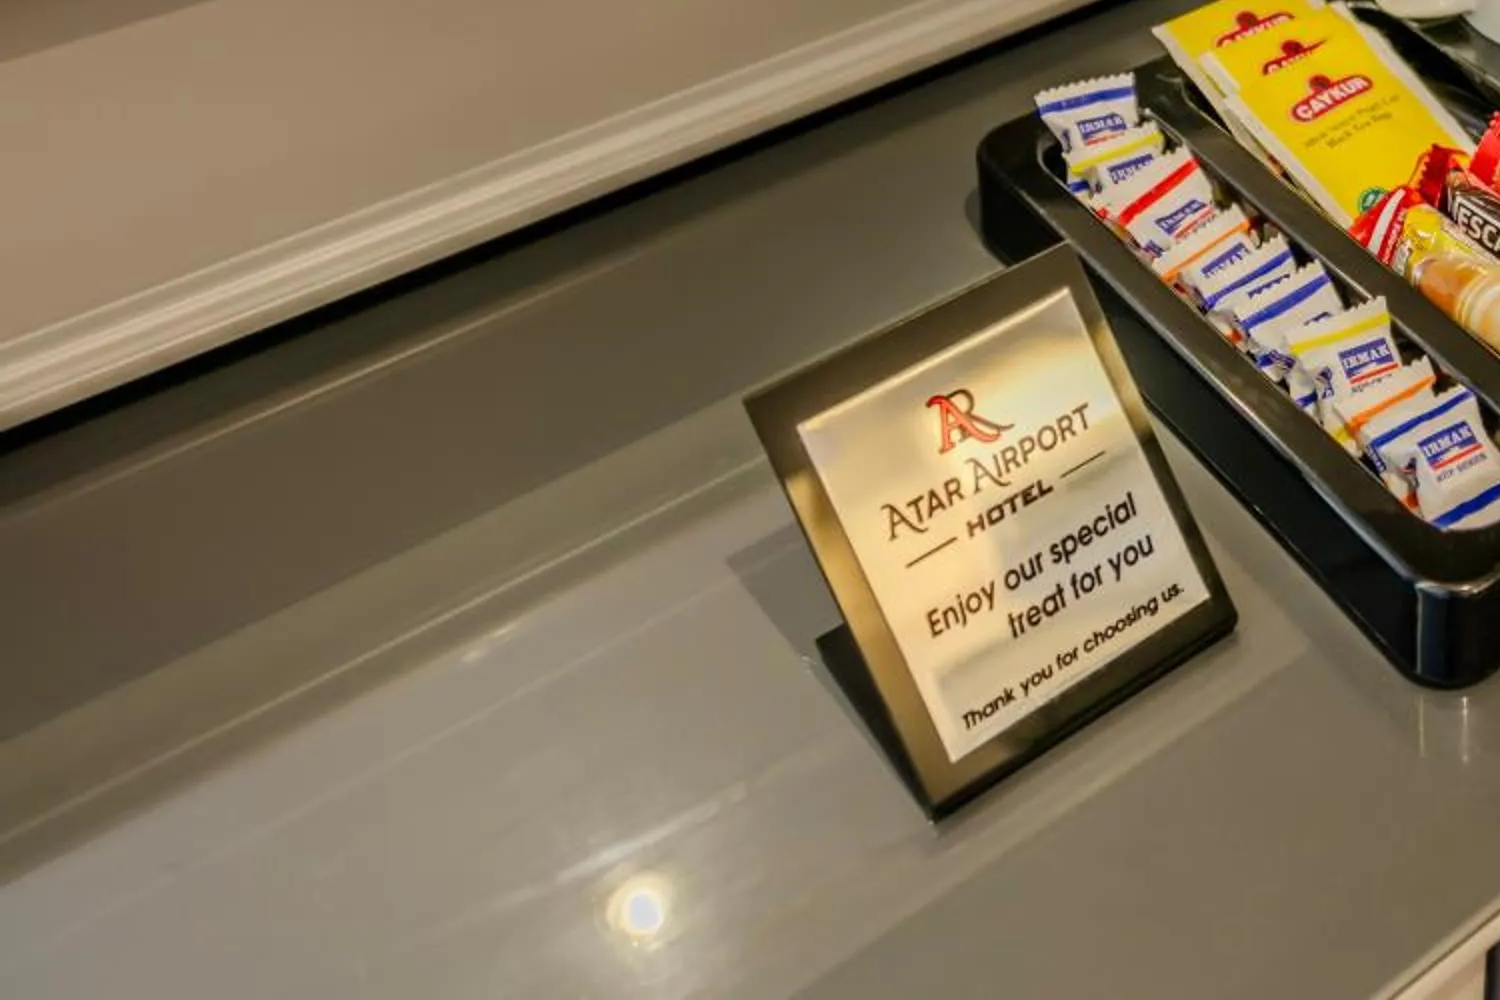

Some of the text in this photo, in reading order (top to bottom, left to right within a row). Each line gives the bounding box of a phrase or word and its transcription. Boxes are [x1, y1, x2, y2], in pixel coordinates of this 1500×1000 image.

[880, 402, 1089, 541] ATAR AIRPORT
[966, 479, 1054, 537] HOTEL
[926, 491, 1137, 638] Enjoy our special
[1008, 535, 1155, 638] treat for you
[961, 582, 1184, 729] Thank you for choosing us.
